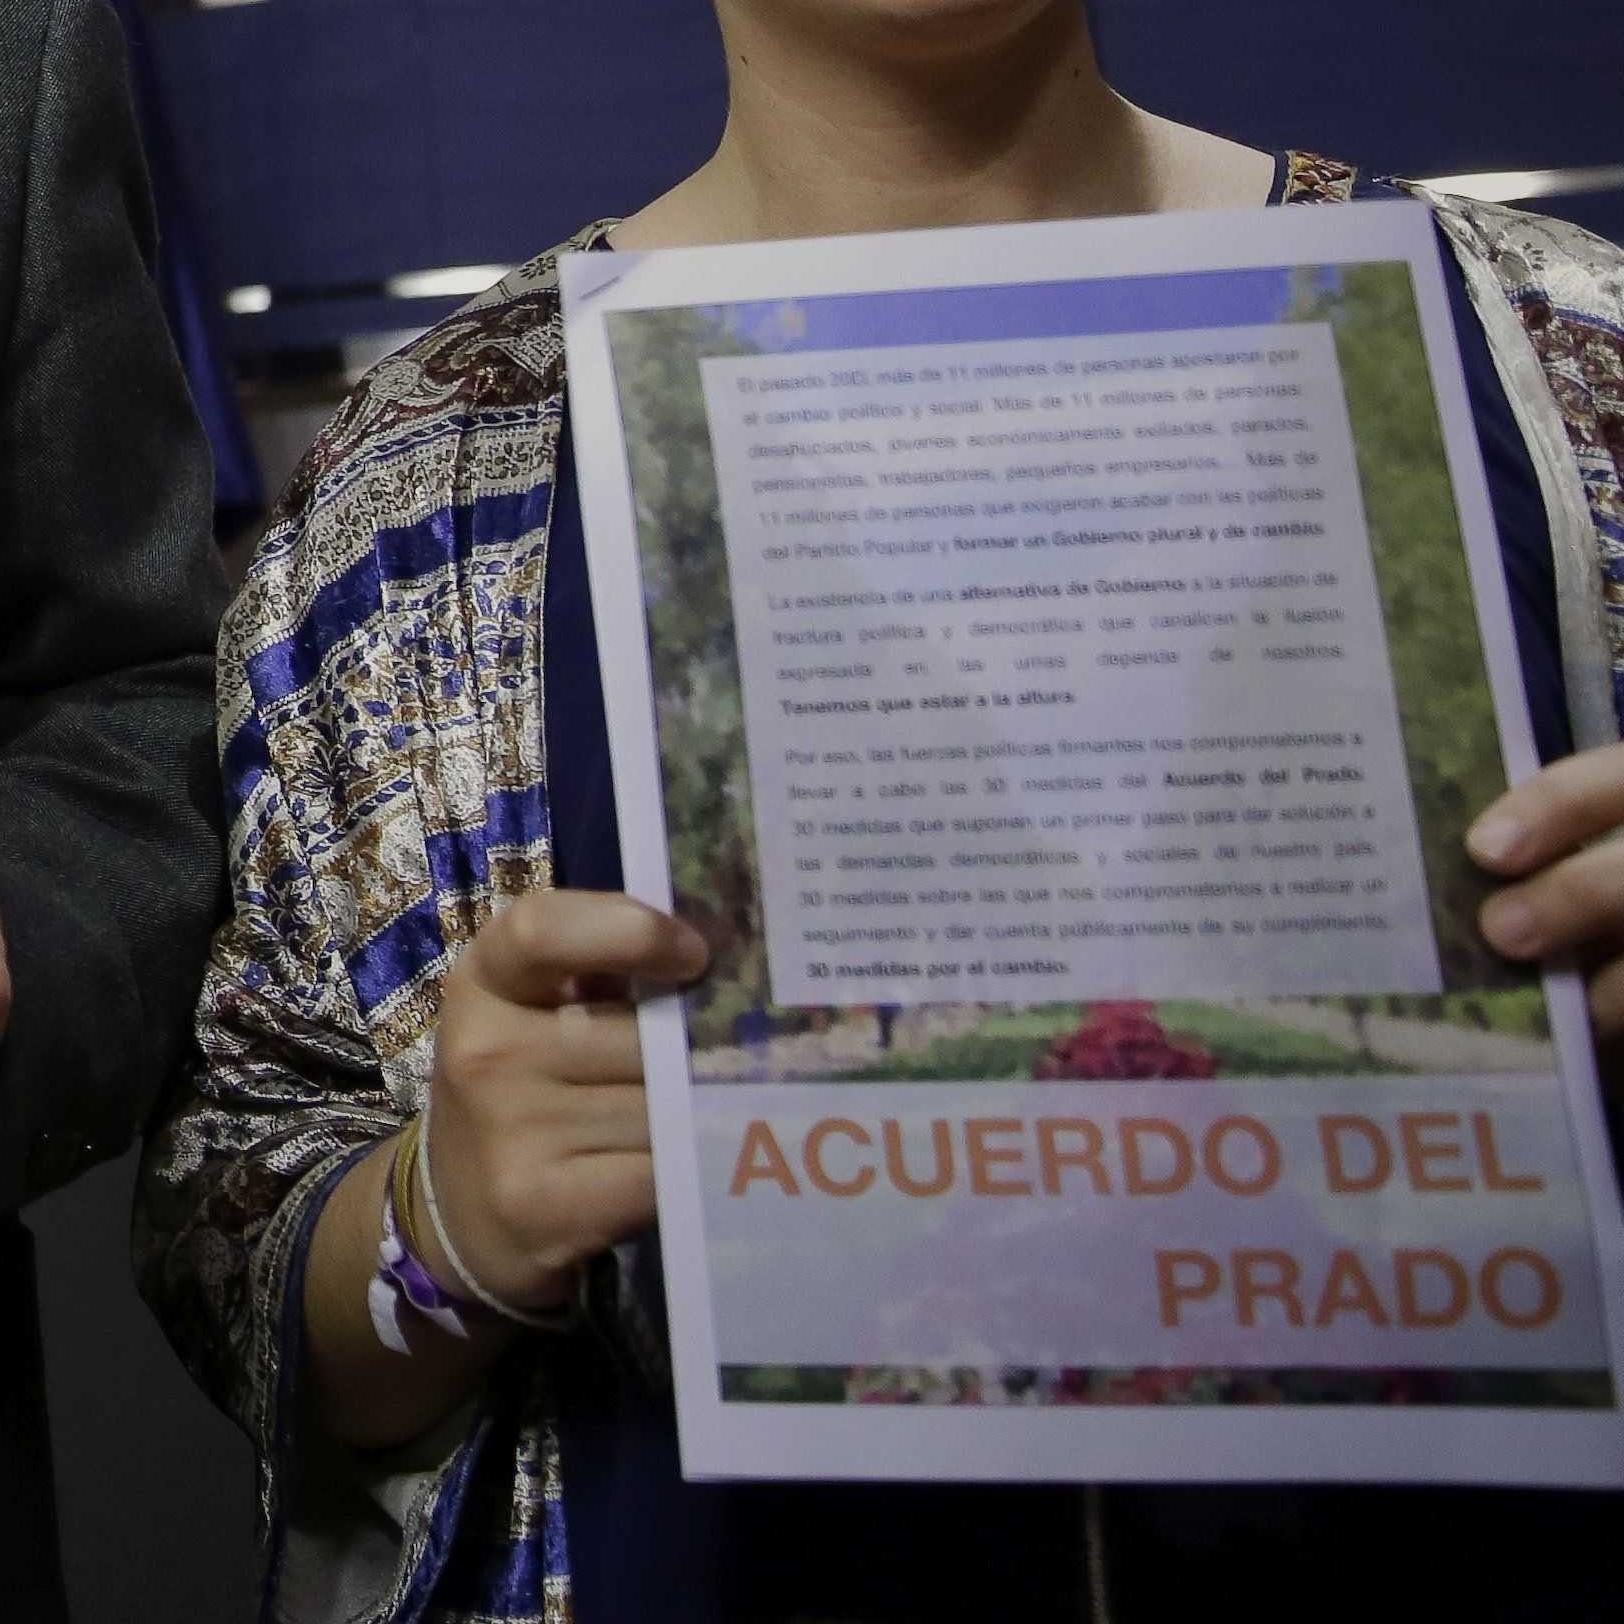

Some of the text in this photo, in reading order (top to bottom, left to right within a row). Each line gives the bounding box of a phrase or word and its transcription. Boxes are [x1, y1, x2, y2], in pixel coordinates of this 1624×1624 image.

[729, 1110, 1545, 1200] ACUERDO DEL
[1153, 1246, 1564, 1332] PRADO
